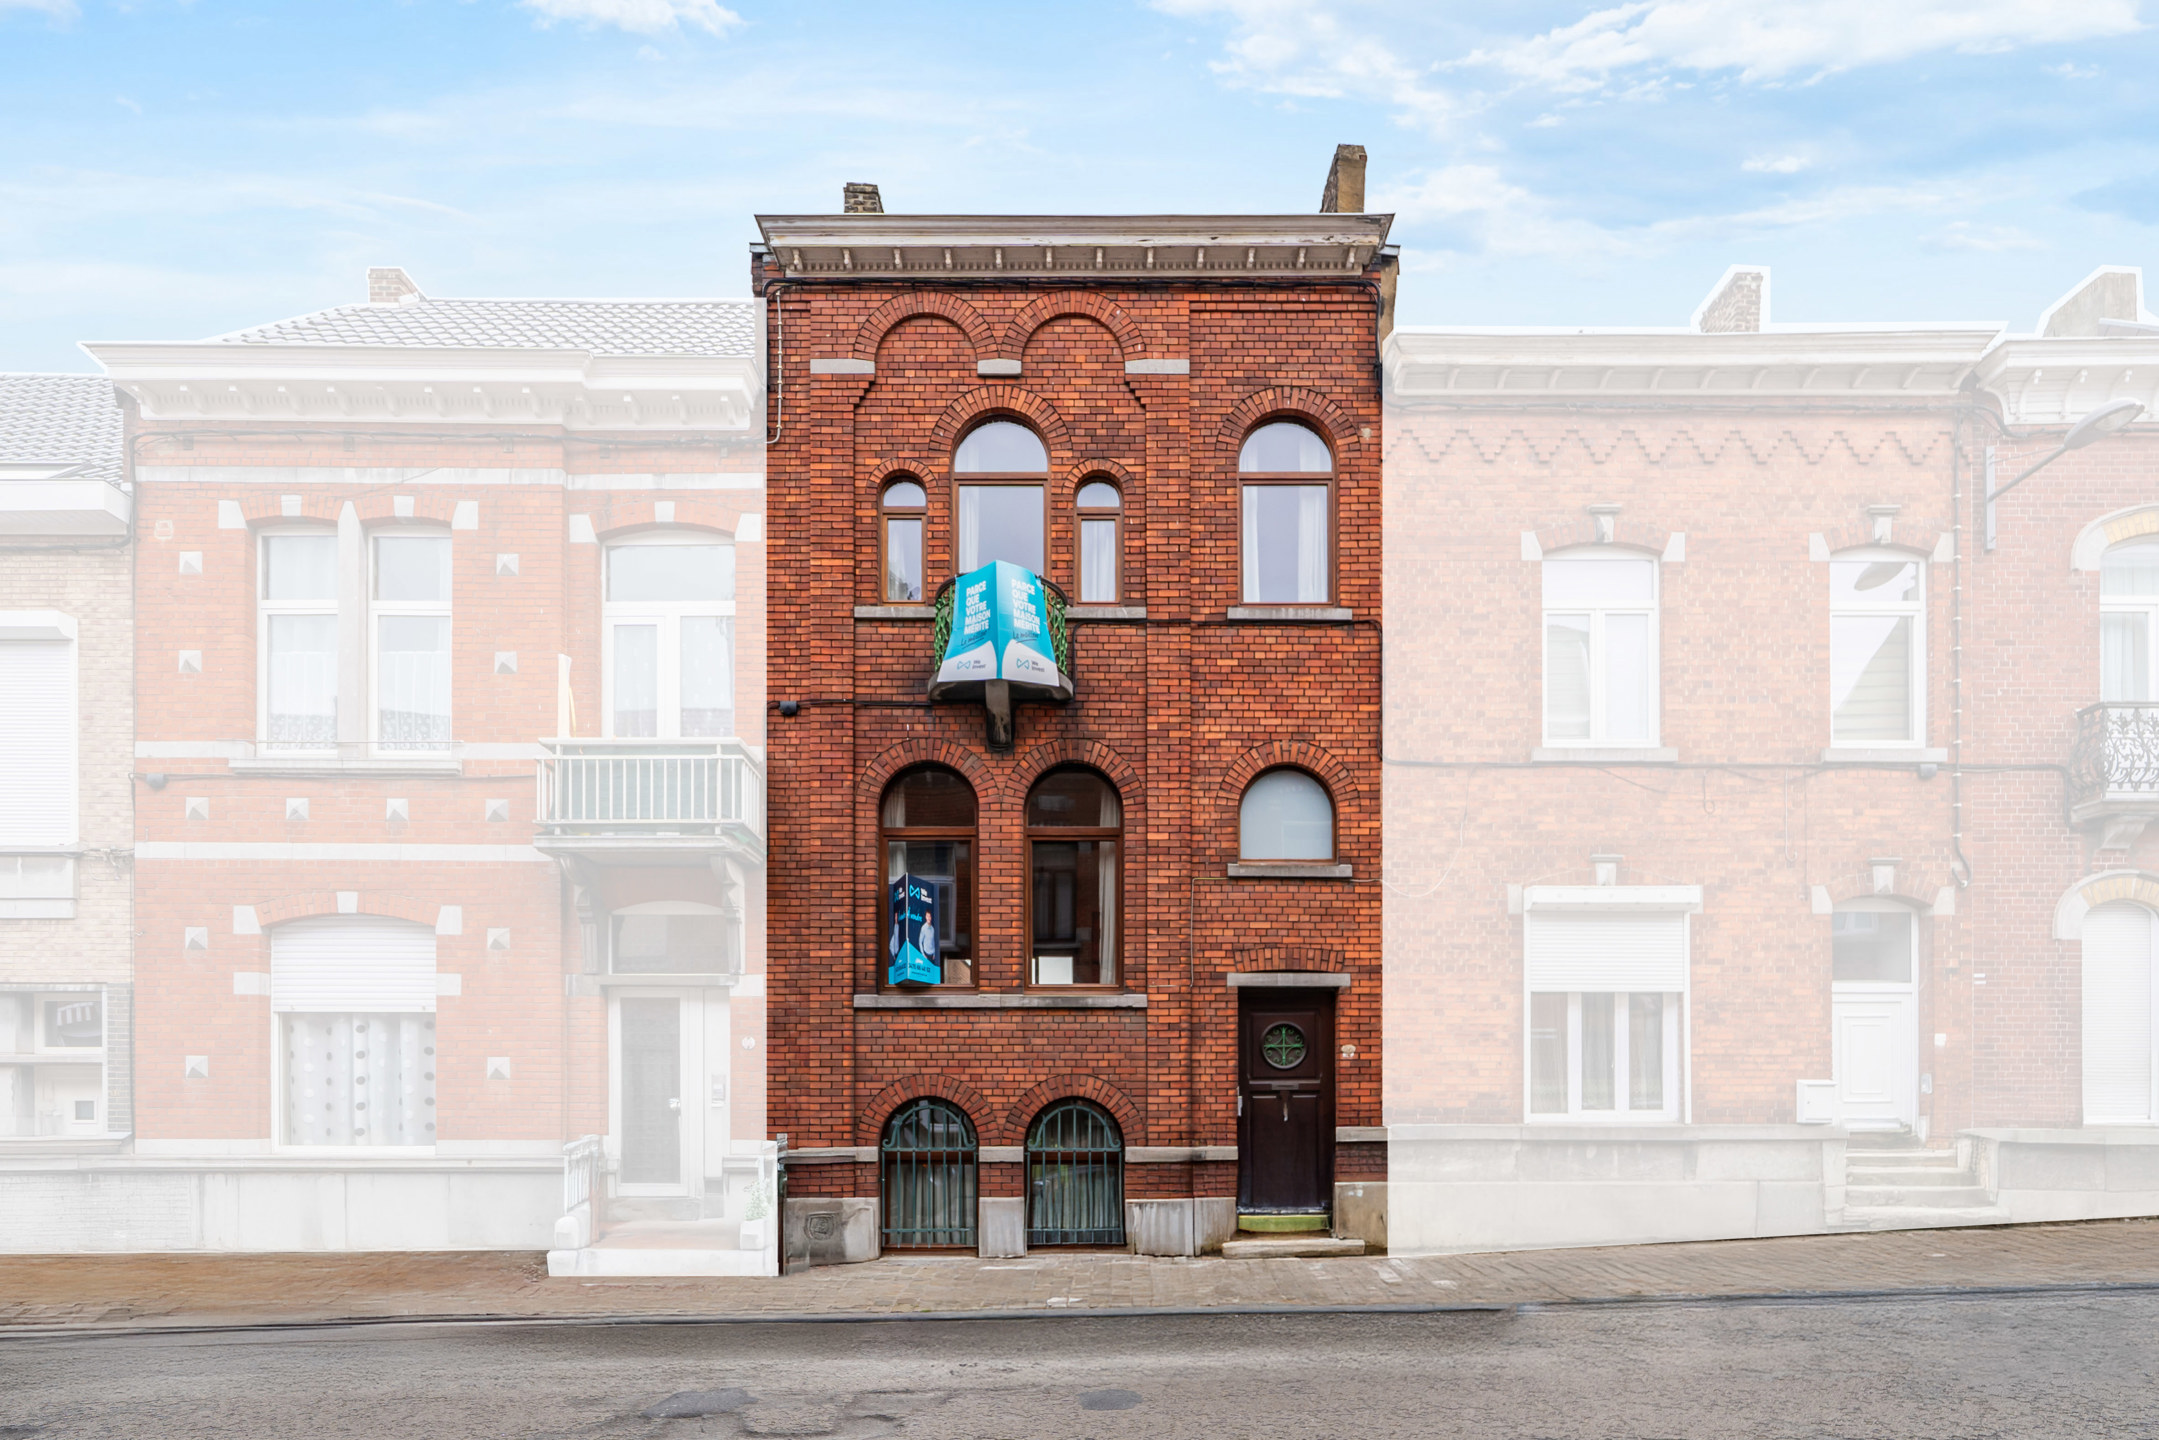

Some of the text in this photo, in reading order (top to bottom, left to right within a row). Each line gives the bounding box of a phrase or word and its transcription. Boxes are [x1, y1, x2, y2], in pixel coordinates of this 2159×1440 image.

[966, 580, 987, 598] PARCE
[1011, 578, 1035, 596] PARCE
[1012, 588, 1029, 603] QUE
[965, 600, 987, 616] VOTRE
[966, 593, 980, 607] QUE
[1012, 598, 1036, 615] VOTRE
[965, 608, 991, 626] MAISON
[1013, 607, 1040, 626] MAISON
